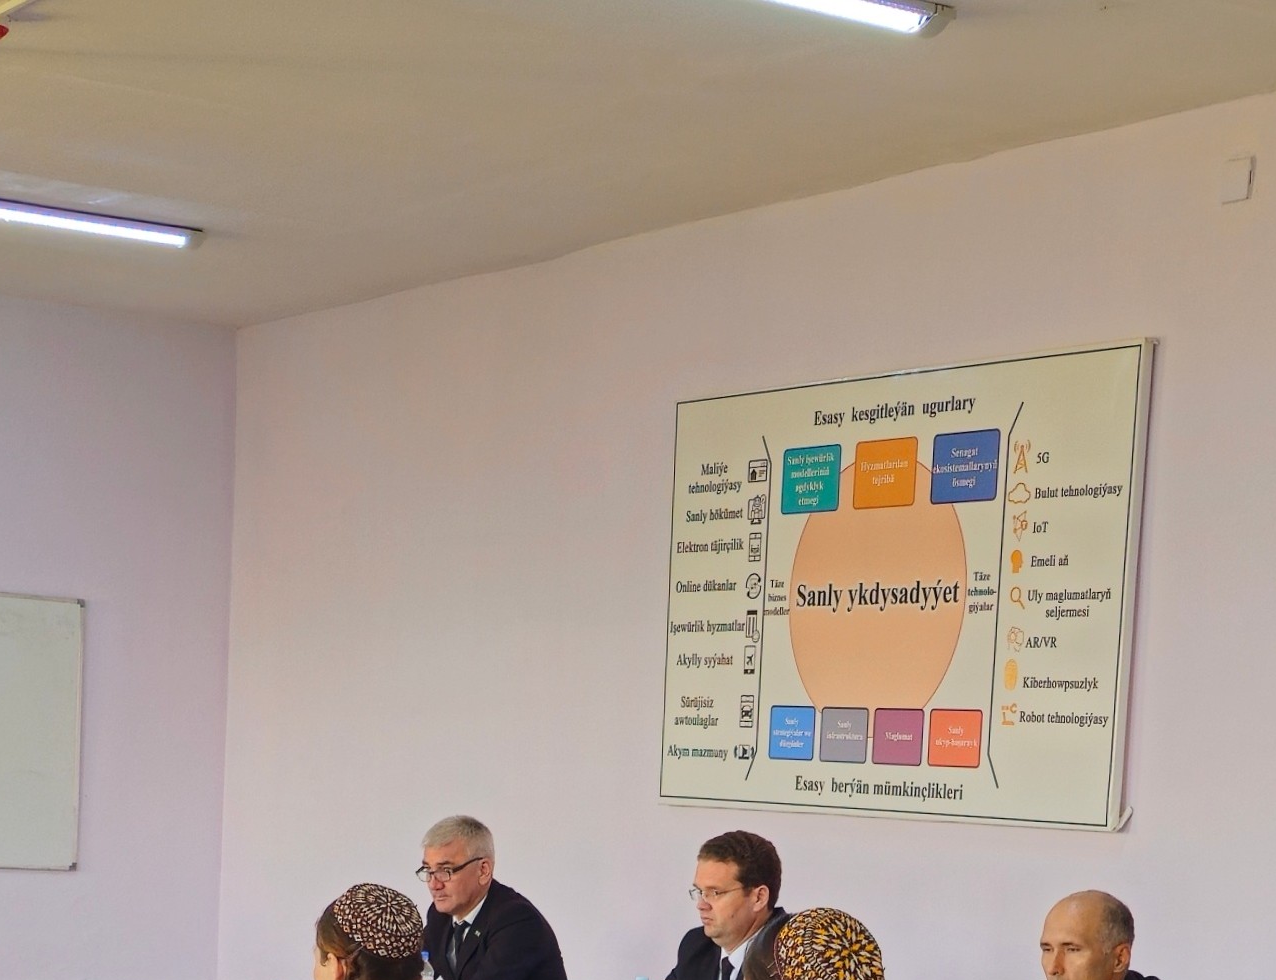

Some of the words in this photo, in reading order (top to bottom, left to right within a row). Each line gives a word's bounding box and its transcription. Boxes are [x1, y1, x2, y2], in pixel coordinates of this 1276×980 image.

[814, 411, 845, 428] Esasy
[851, 401, 915, 424] kesgitleýän
[922, 396, 976, 418] ugurlary
[1036, 451, 1050, 464] 5G
[701, 461, 728, 477] Maliýe
[688, 479, 742, 495] tehnologiýasy
[1034, 486, 1059, 499] Bulut
[1061, 483, 1123, 498] tehnologiýasy
[686, 509, 707, 524] Sanly
[1032, 521, 1049, 534] IoT
[677, 541, 708, 553] Elektron
[1030, 554, 1056, 568] Emeli
[973, 571, 991, 582] Täze
[676, 580, 704, 593] Online
[703, 579, 737, 592] dükanlar
[796, 583, 843, 613] Sanly
[847, 579, 960, 612] ykdysadyýet
[1027, 589, 1043, 603] Uly
[1045, 588, 1112, 603] maglumatlaryň
[1045, 605, 1090, 621] seljermesi
[706, 619, 745, 635] hyzmatlar
[1025, 637, 1057, 648] AR/VR
[676, 653, 702, 668] Akylly
[704, 653, 733, 668] syýahat
[1022, 677, 1099, 692] Kiberhowpsuzlyk
[680, 696, 714, 711] Sürüjisiz
[674, 714, 719, 729] awtoulaglar
[1019, 711, 1045, 723] Robot
[1047, 712, 1109, 728] tehnologiýasy
[667, 744, 690, 760] Akym
[692, 748, 728, 761] mazmuny
[794, 775, 825, 796] Esasy
[831, 777, 869, 798] berýän
[873, 781, 964, 802] mümkinçlikleri
